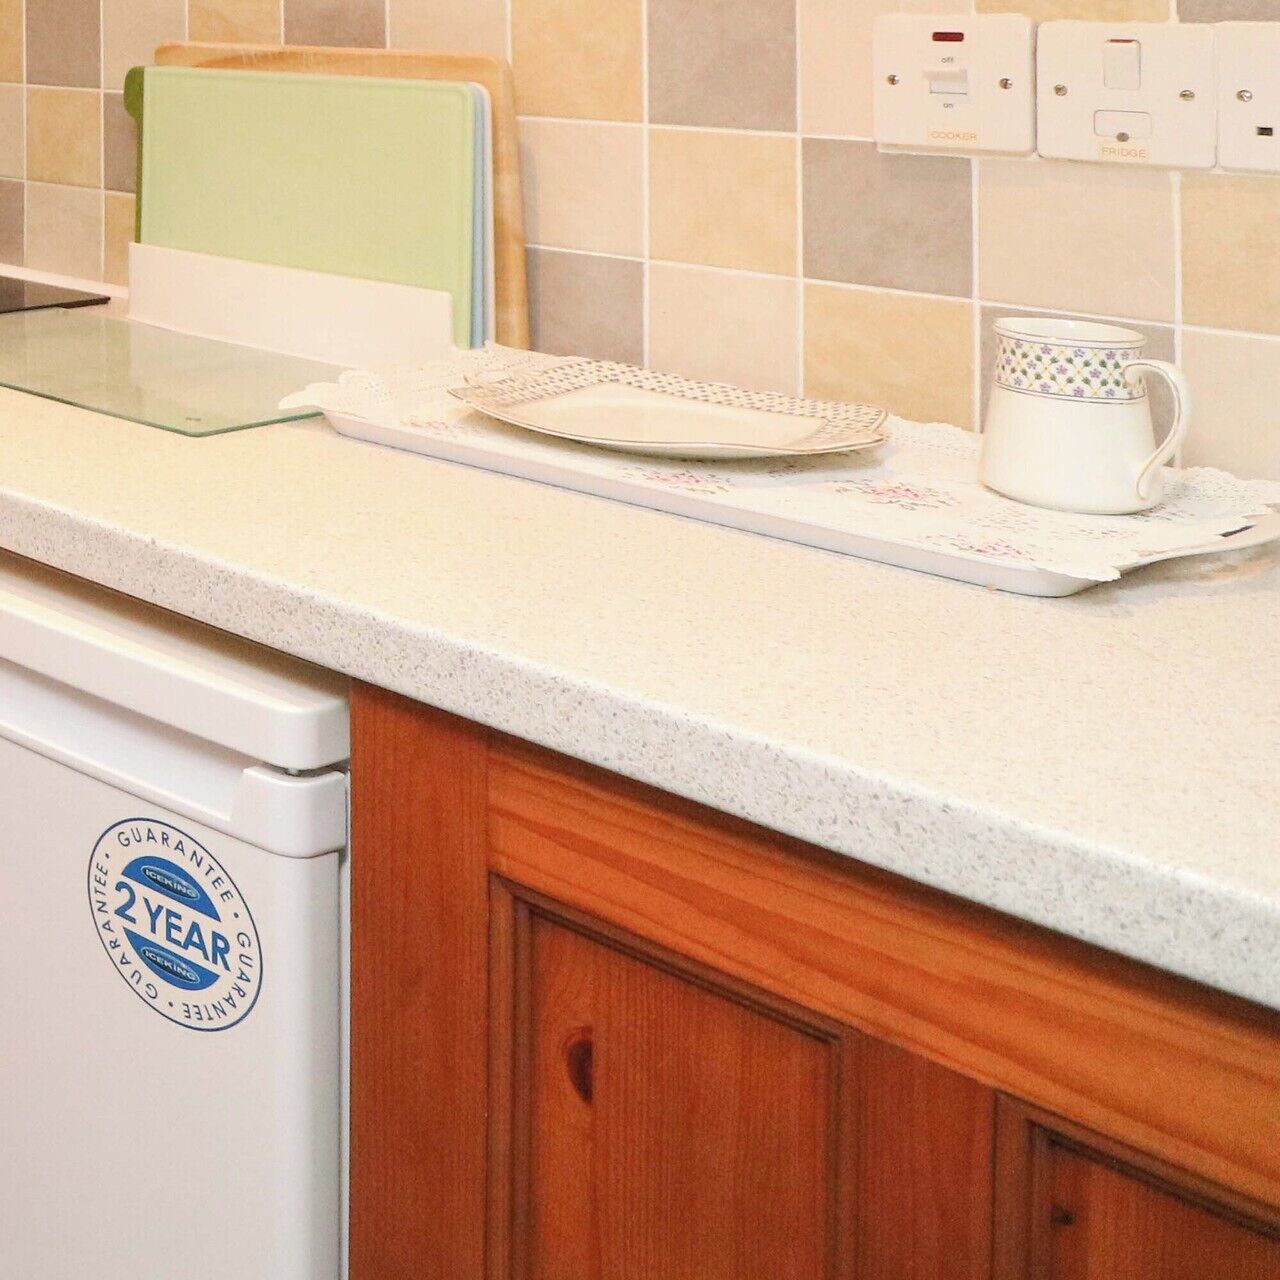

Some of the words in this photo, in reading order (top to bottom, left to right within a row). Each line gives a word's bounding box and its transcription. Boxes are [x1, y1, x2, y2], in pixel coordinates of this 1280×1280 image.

[930, 130, 977, 142] COOKER
[1101, 146, 1147, 159] FRIDGE
[117, 827, 234, 903] GUARANTEE
[145, 868, 198, 898] ICEKING
[94, 861, 158, 1000] GUARANTEE
[113, 880, 137, 925] 2
[142, 896, 231, 972] YEAR
[145, 949, 197, 980] ICEKING
[182, 931, 254, 1021] GUARANTEE
